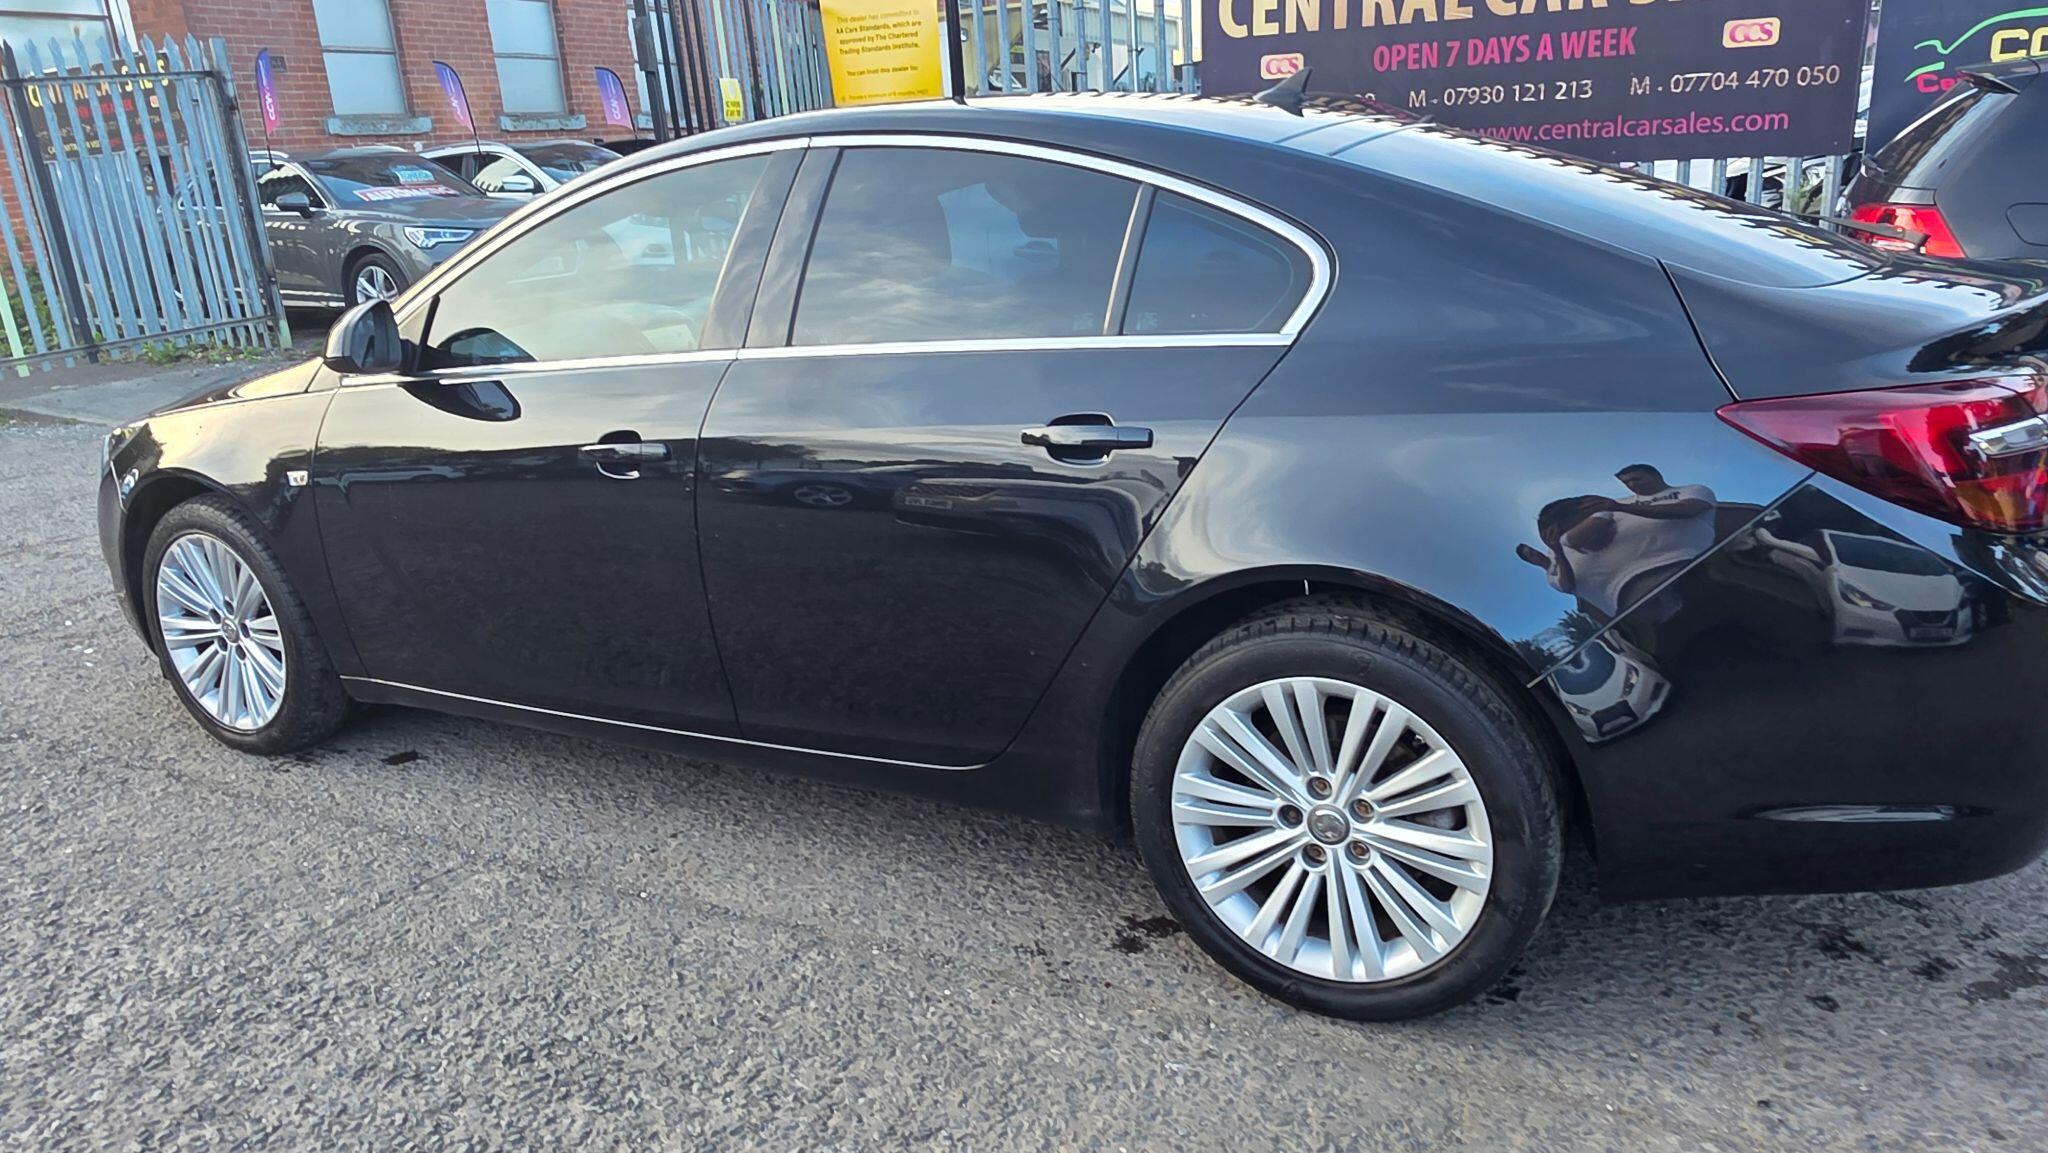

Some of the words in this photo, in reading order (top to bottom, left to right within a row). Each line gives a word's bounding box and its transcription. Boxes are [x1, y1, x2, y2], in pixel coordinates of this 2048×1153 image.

[888, 31, 918, 40] Chartered
[1374, 42, 1437, 72] OPEN
[1446, 41, 1460, 68] 7
[1467, 35, 1530, 66] DAYS
[1536, 33, 1554, 61] A
[1561, 27, 1638, 59] WEEK
[1409, 89, 1426, 107] M
[1444, 84, 1504, 106] 07930
[1513, 83, 1545, 103] 121
[1554, 79, 1593, 100] 213
[1630, 76, 1650, 95] M
[1670, 71, 1740, 93] 07704
[1745, 68, 1789, 88] 470
[1796, 65, 1840, 86] 050
